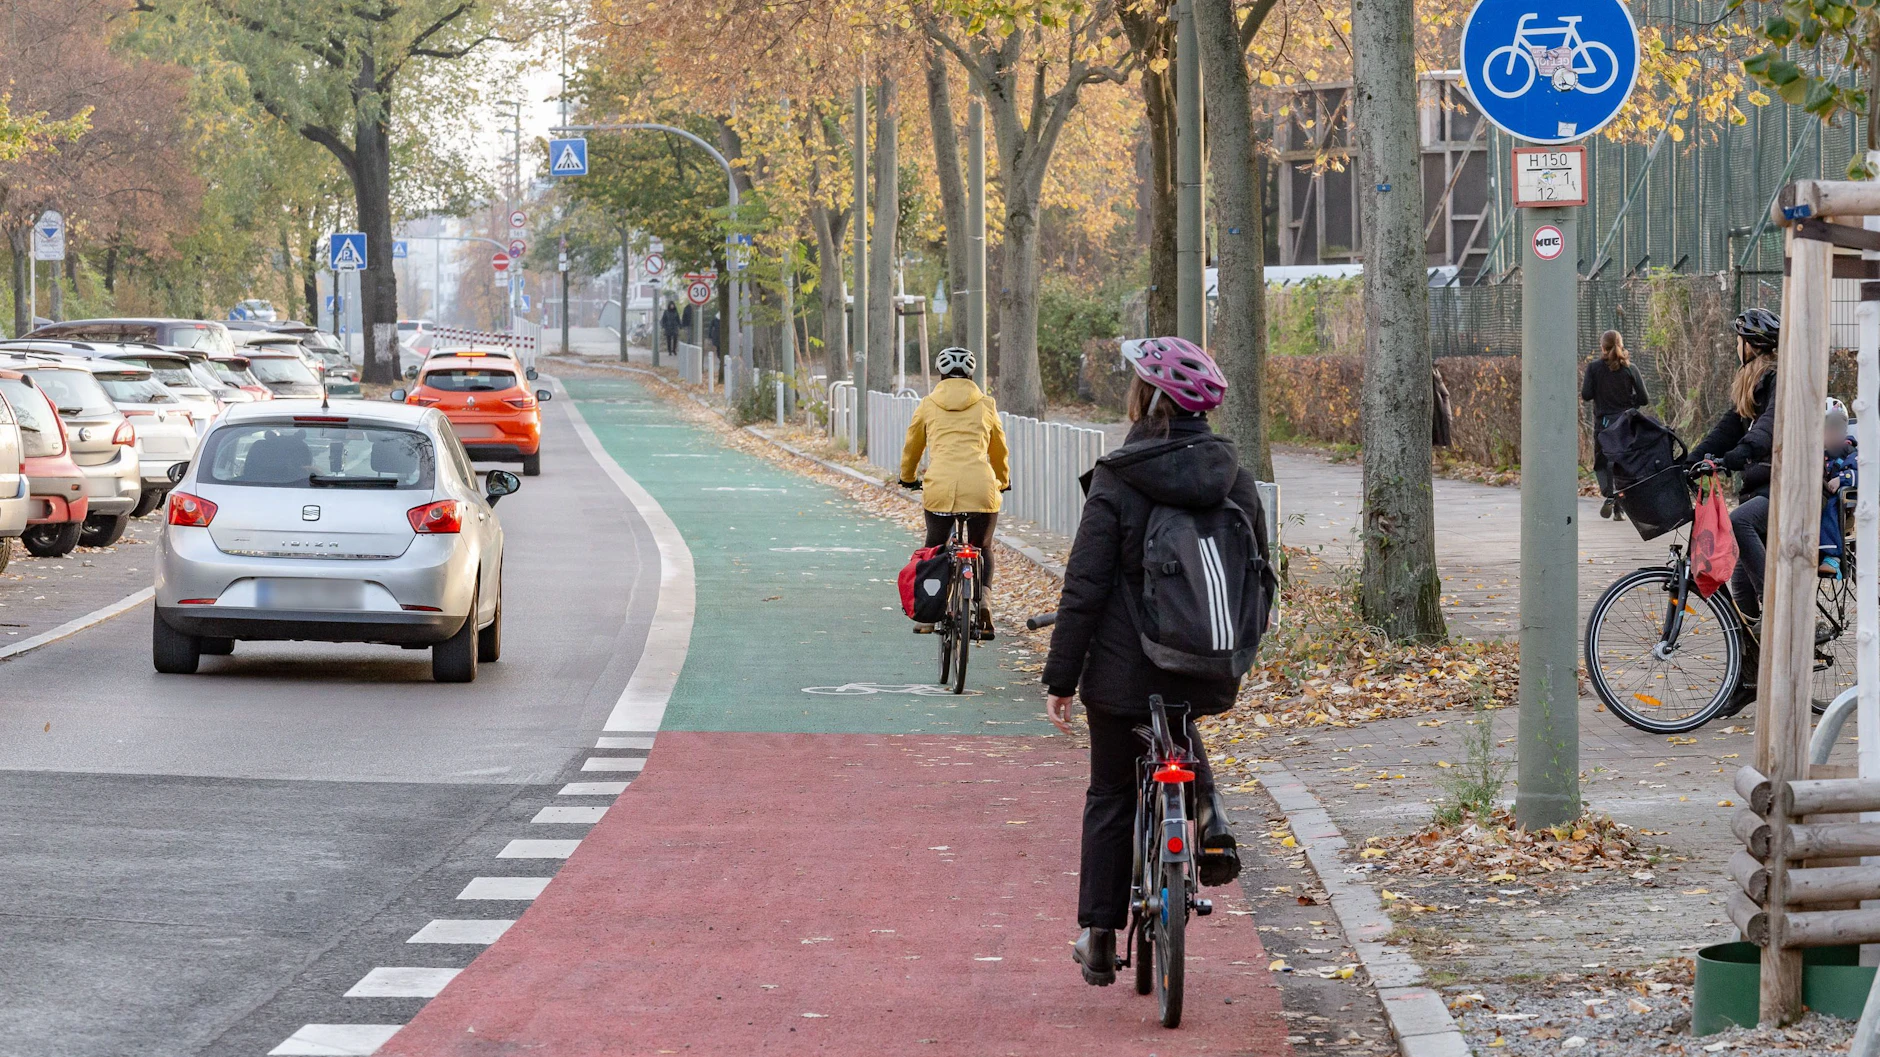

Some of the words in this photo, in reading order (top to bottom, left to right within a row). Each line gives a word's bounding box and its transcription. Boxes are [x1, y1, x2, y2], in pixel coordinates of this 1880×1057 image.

[1529, 153, 1568, 167] H150
[1563, 172, 1570, 185] 1
[1538, 187, 1555, 201] 12
[692, 287, 707, 298] 30
[281, 540, 339, 548] IBIZA
